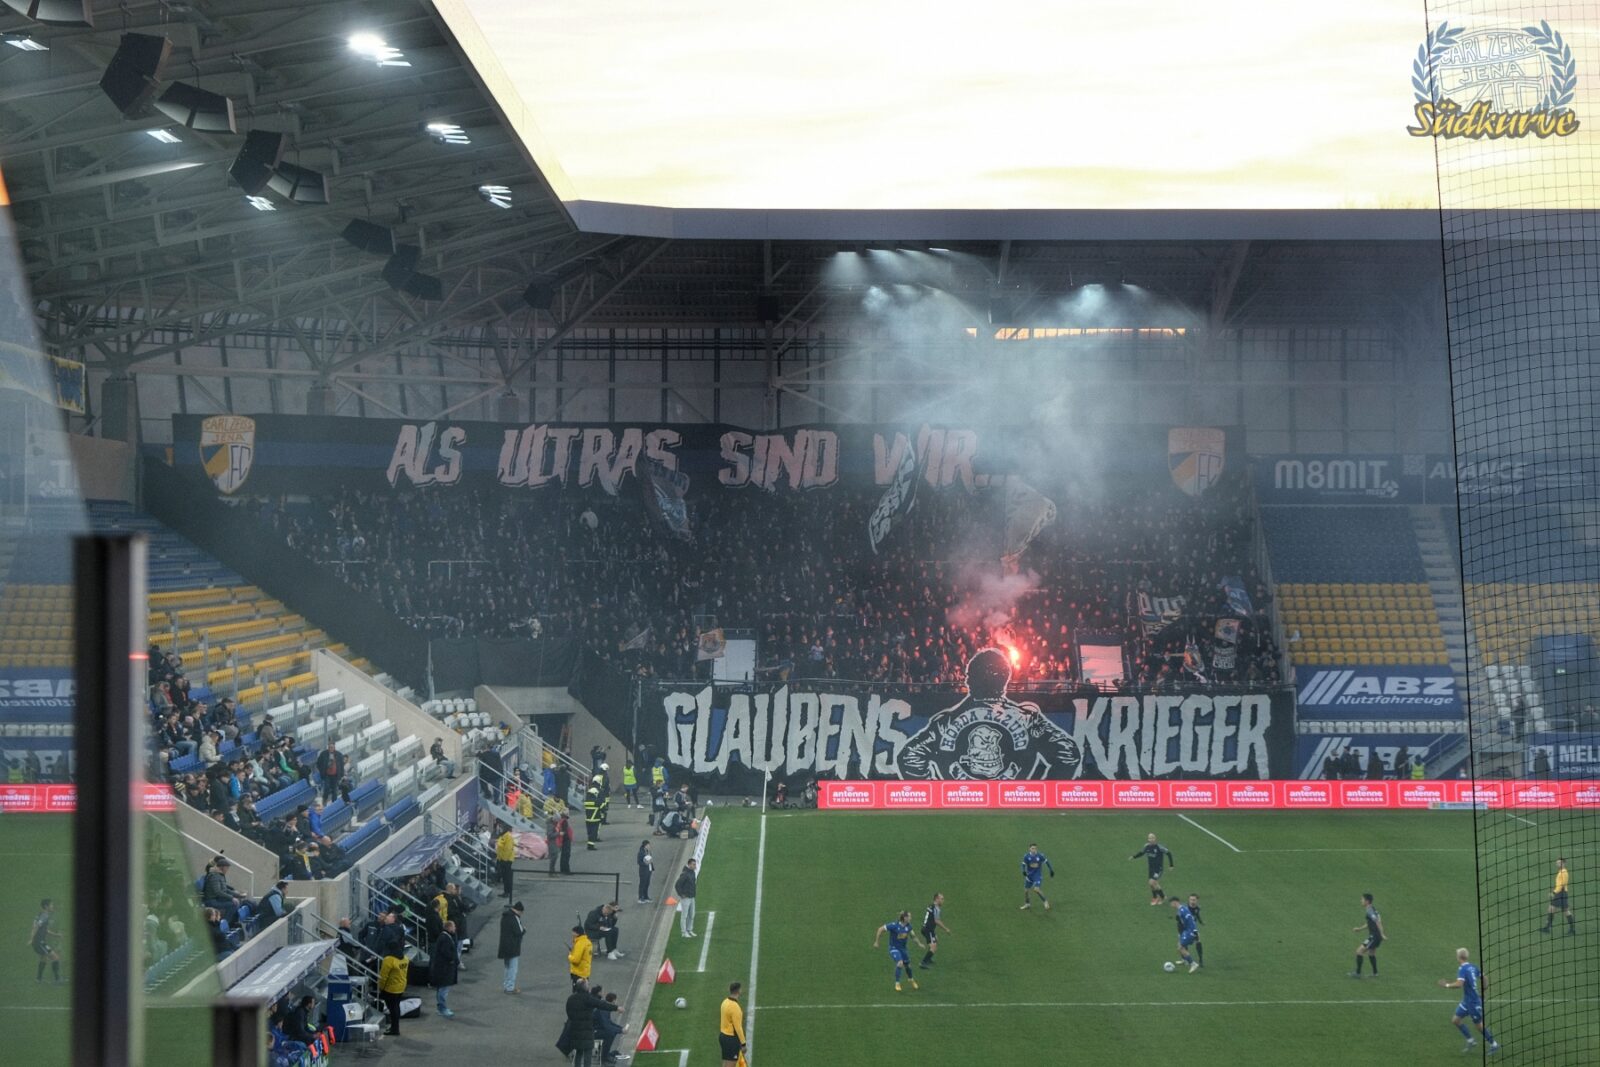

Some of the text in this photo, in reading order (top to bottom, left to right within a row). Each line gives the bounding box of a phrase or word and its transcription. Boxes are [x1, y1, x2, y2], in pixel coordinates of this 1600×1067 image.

[387, 421, 465, 488] ALS
[499, 423, 684, 496] ULTRAS
[718, 429, 840, 493] SIND
[1343, 677, 1455, 695] ABZ
[1336, 695, 1453, 706] Nutzfahrzeuge
[663, 684, 1271, 780] GLAUBENS KRIEGER
[941, 710, 980, 749] HORDA
[1559, 745, 1600, 762] MEL
